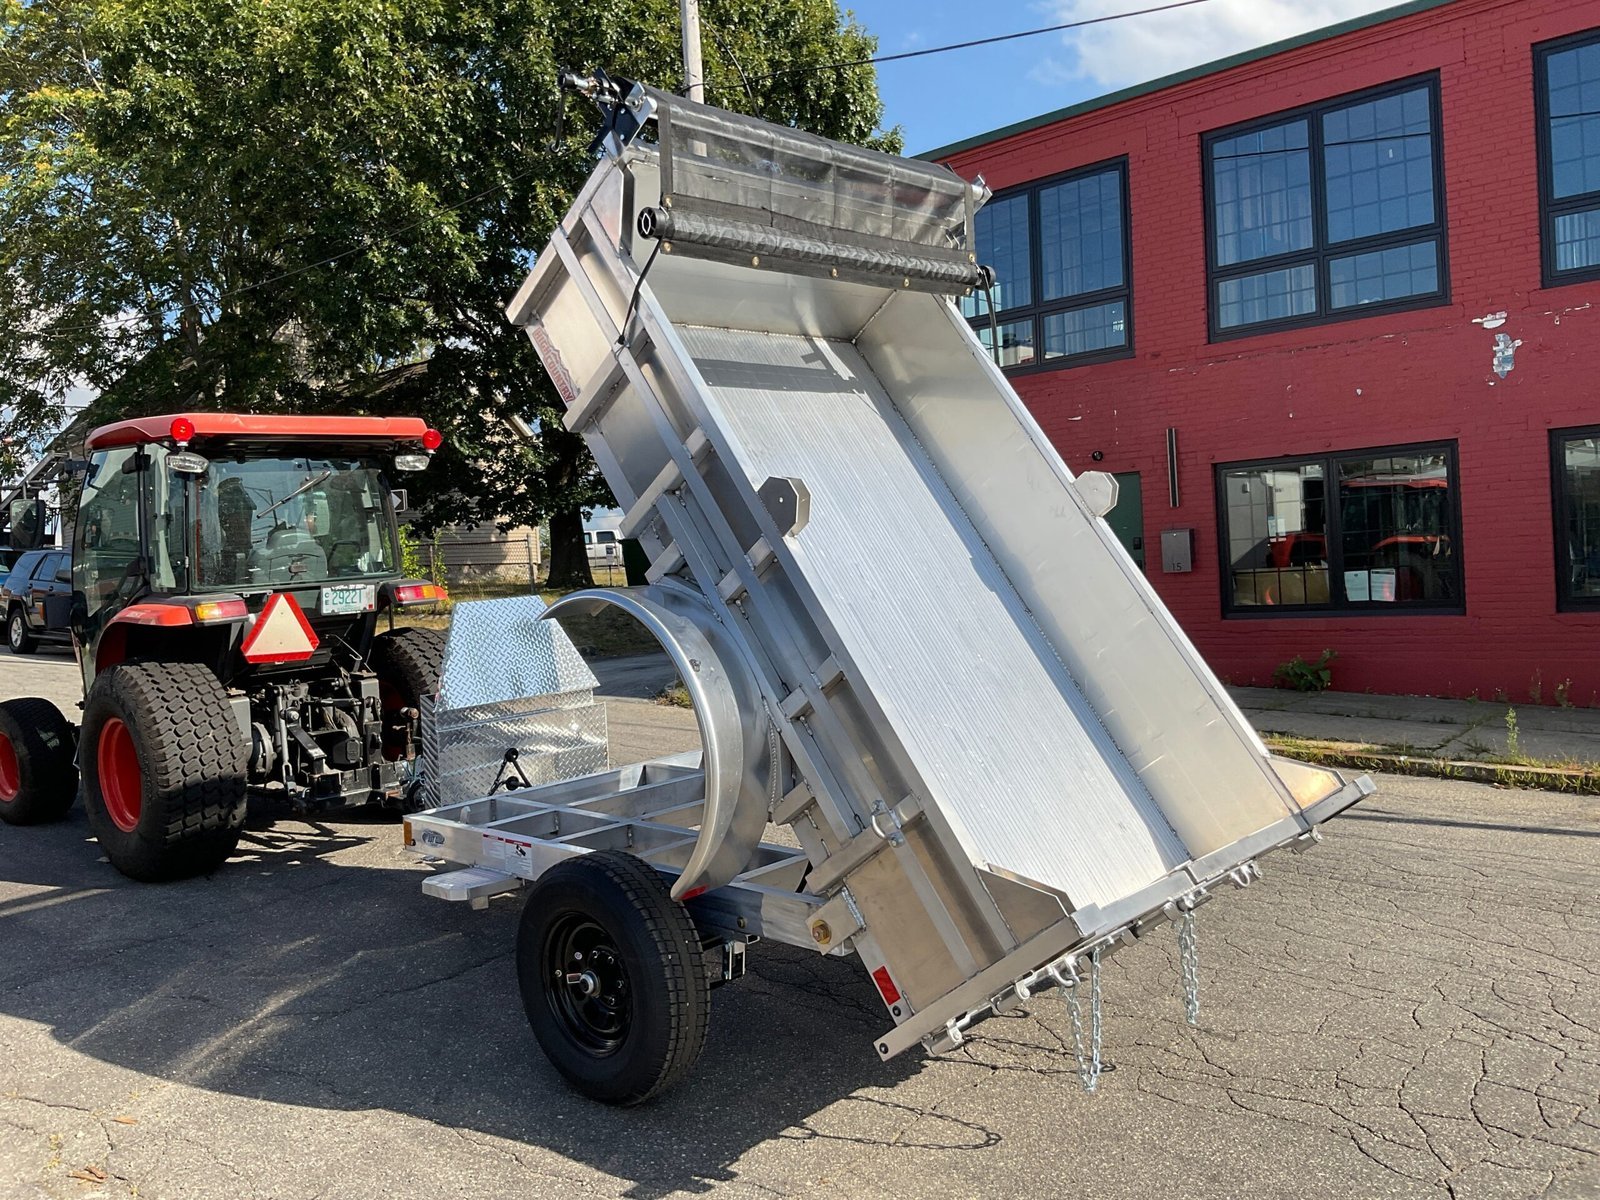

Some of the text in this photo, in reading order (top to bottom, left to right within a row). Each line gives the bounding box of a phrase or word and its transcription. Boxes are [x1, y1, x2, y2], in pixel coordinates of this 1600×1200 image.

[533, 329, 574, 401] HIGH COUNTRY
[1172, 562, 1182, 571] 15
[332, 589, 362, 606] 29221
